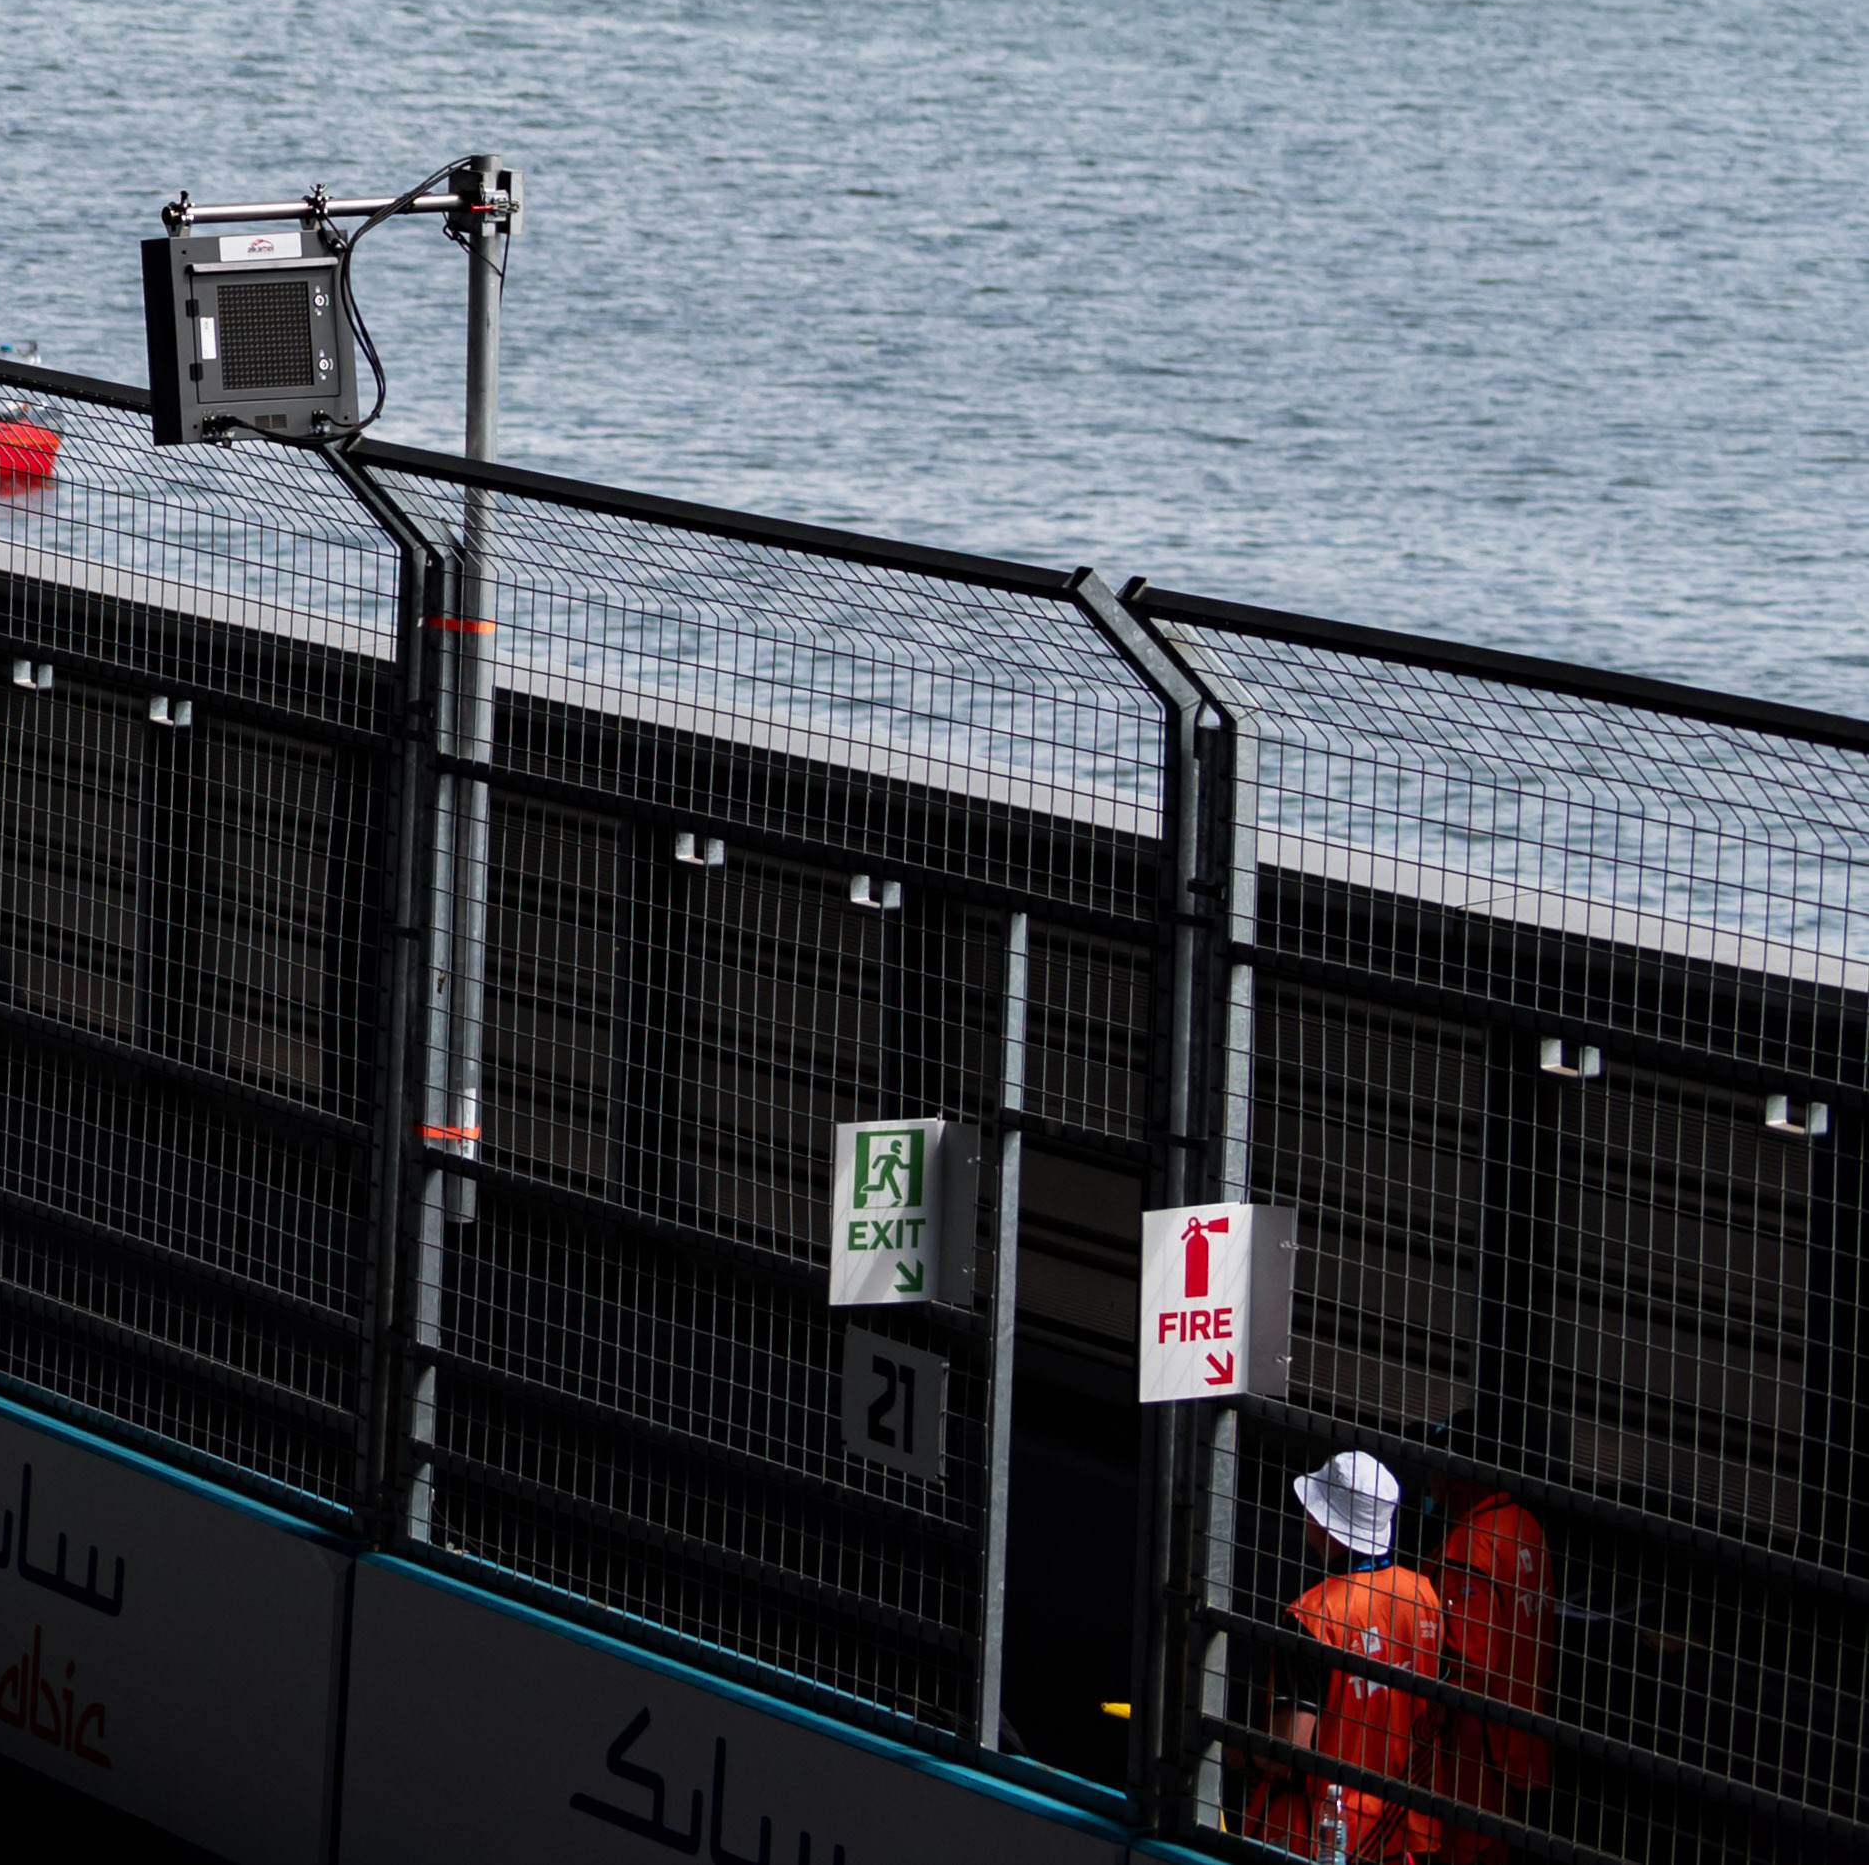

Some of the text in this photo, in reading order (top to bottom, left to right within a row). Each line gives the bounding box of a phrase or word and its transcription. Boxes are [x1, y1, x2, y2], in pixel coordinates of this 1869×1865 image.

[847, 1218, 926, 1252] EXIT
[1158, 1307, 1234, 1344] FIRE
[866, 1353, 918, 1456] 21
